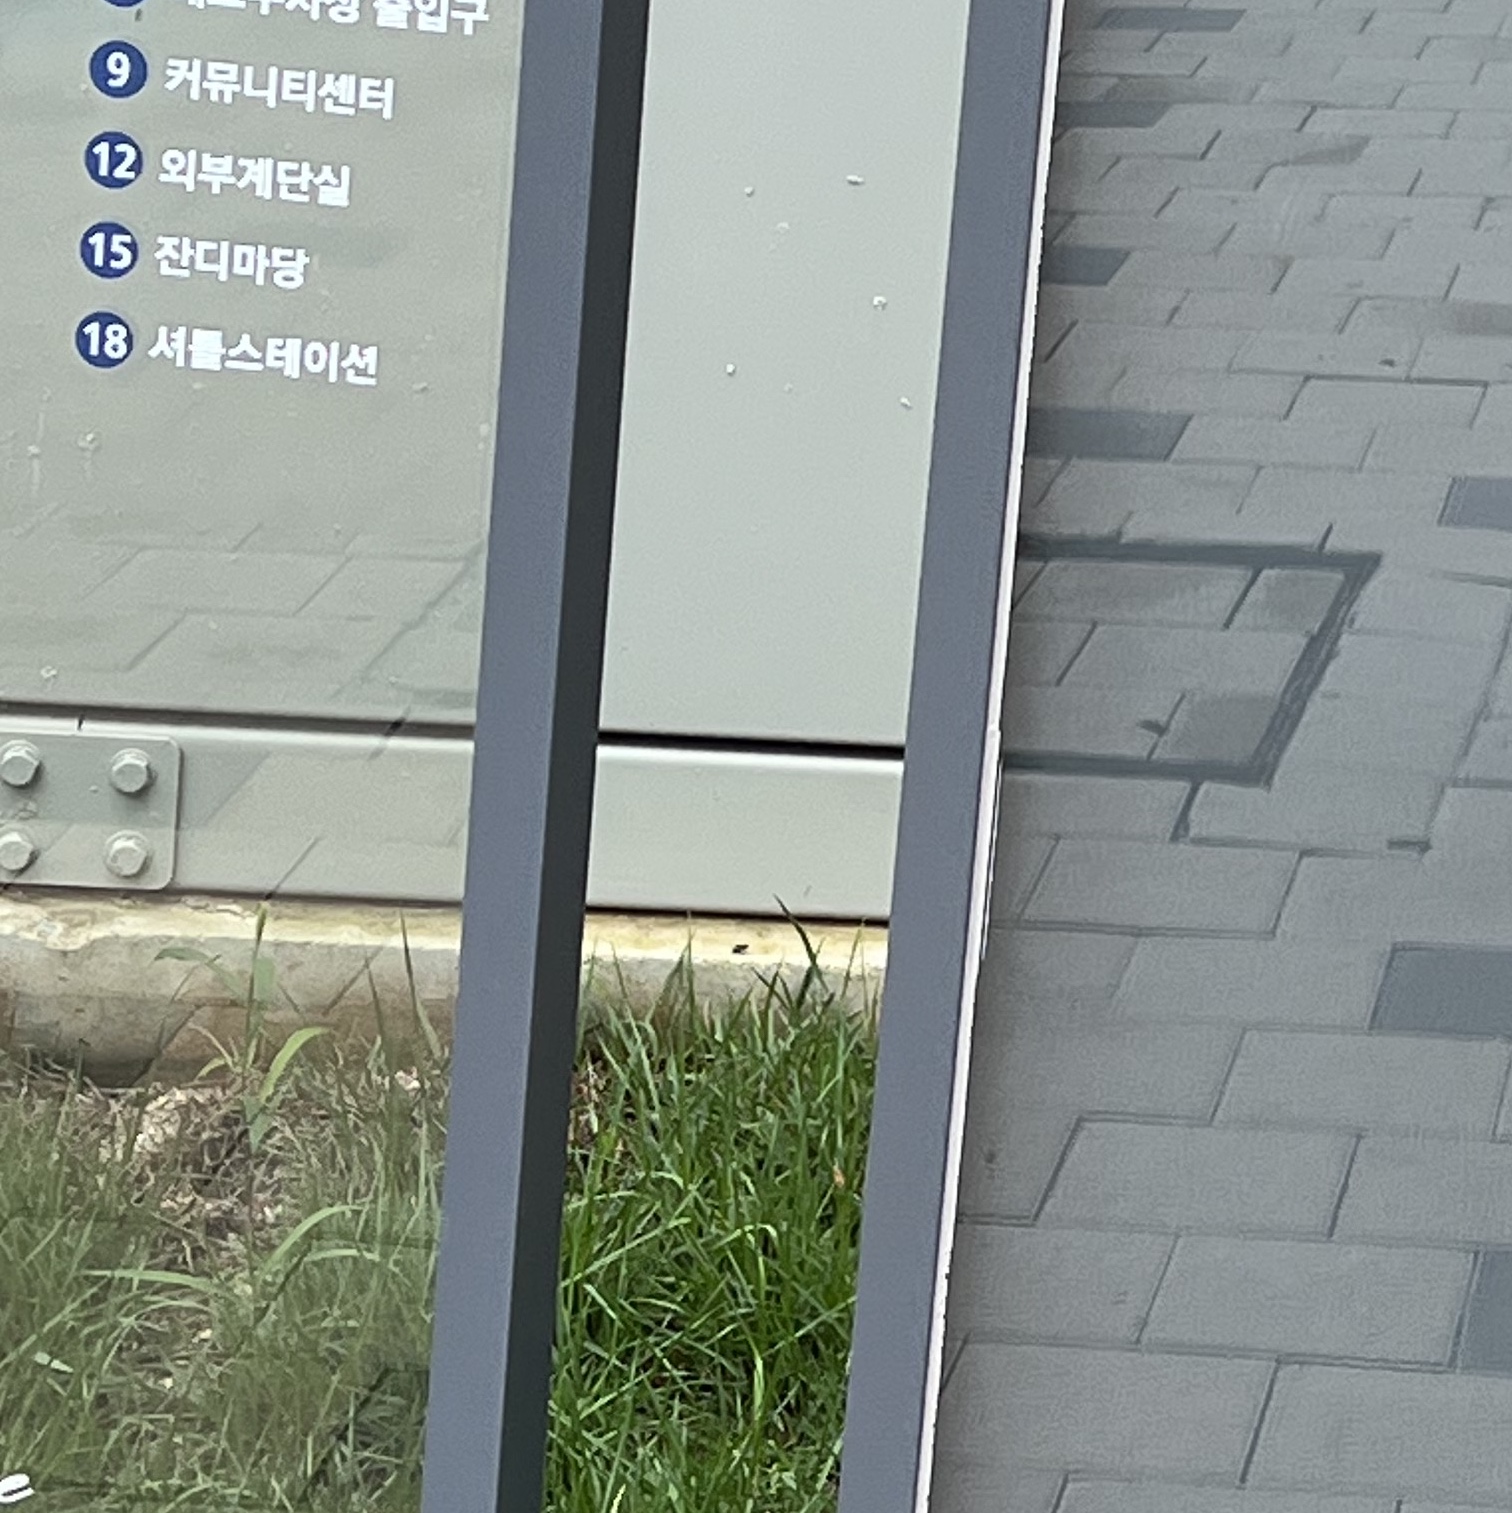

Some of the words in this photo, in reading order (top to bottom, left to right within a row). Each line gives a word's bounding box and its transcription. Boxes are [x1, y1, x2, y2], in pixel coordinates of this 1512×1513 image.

[107, 52, 130, 87] 9
[164, 58, 394, 120] 커뮤니티센터
[92, 141, 136, 179] 12
[158, 149, 350, 207] 외부계단실
[88, 232, 132, 269] 15
[153, 235, 310, 289] 잔디마당
[83, 322, 128, 360] 18
[147, 326, 378, 386] 셔틀스테이션
